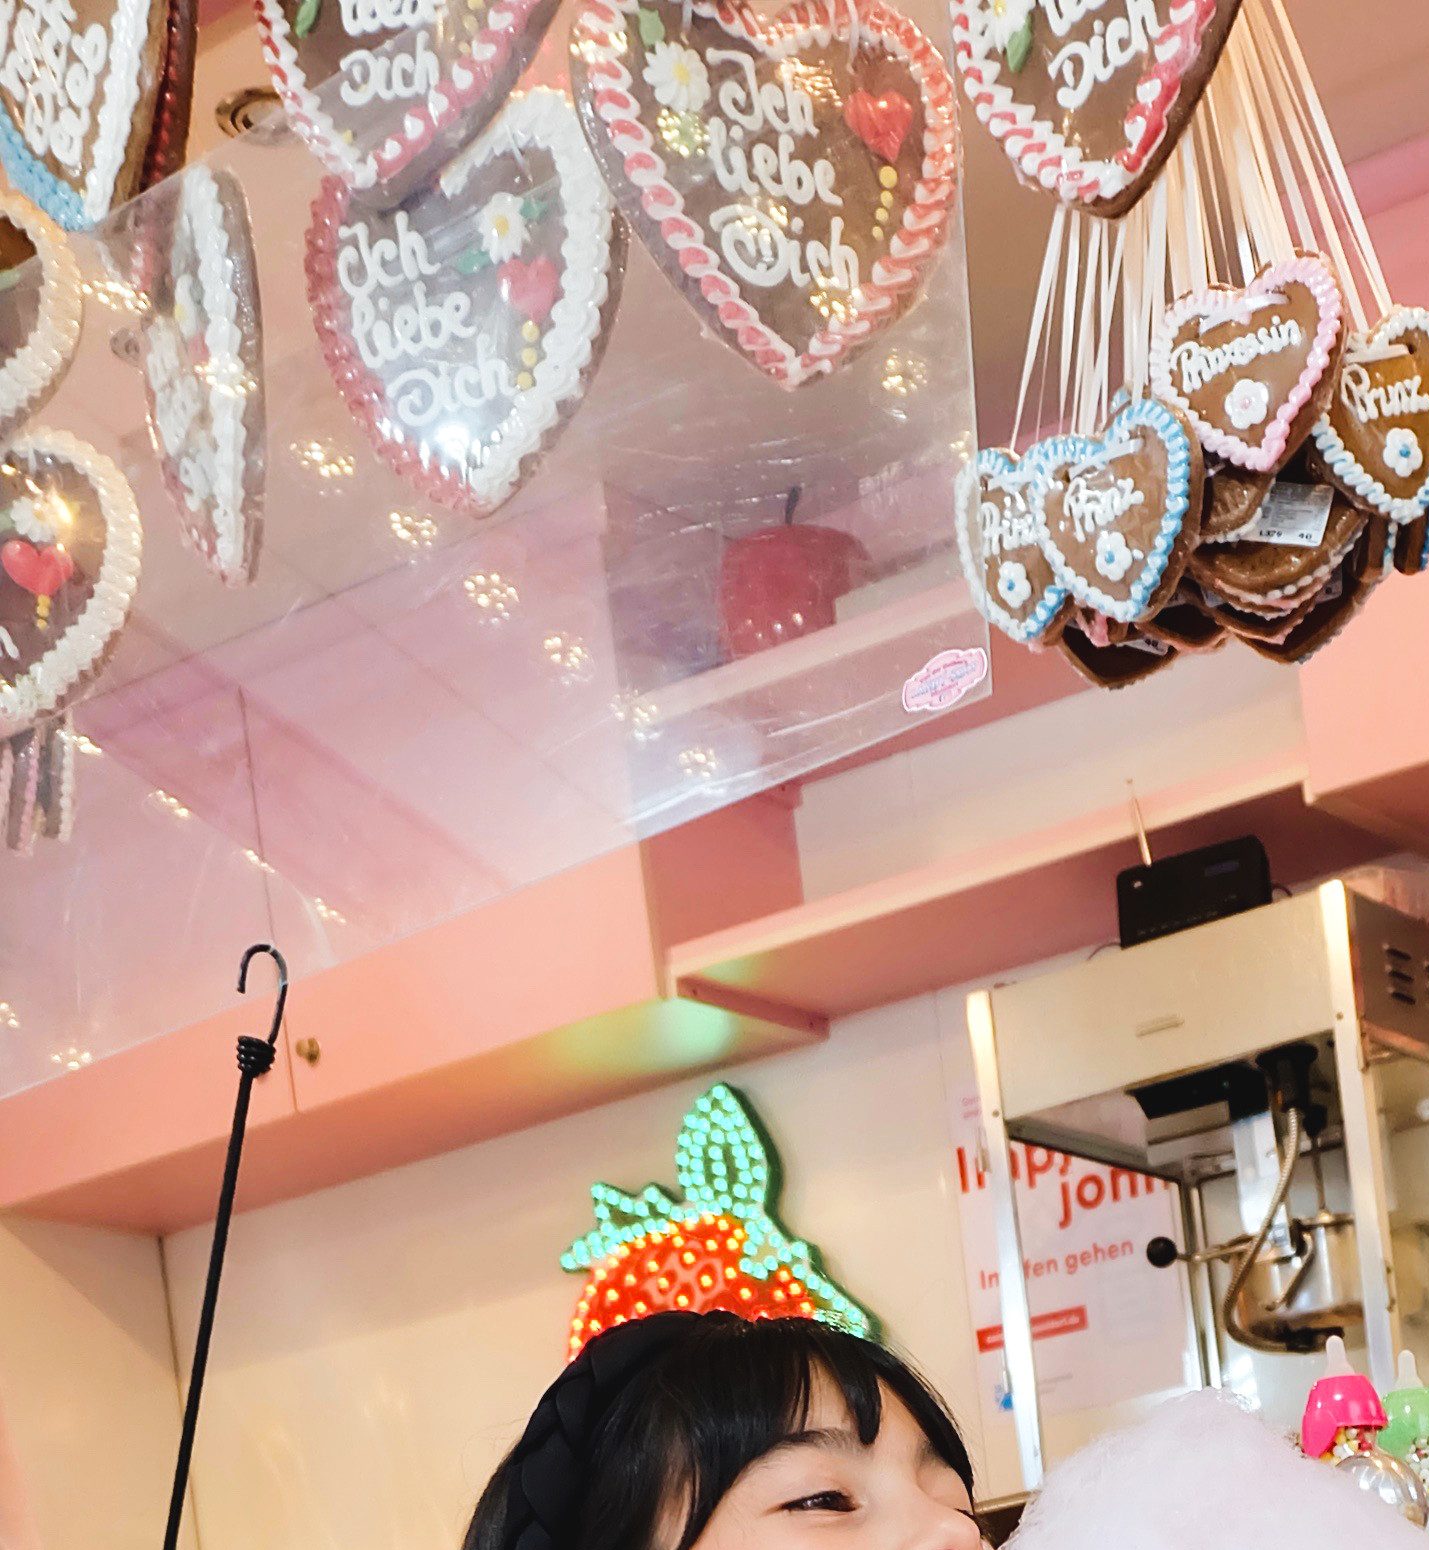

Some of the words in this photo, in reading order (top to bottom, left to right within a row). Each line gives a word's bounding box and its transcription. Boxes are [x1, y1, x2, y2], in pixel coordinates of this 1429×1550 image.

[1048, 0, 1164, 109] Dich
[708, 116, 843, 205] liebe
[709, 204, 862, 297] Dich
[351, 280, 477, 369] liebe
[386, 333, 520, 427] Dich
[1064, 1239, 1135, 1275] gehen
